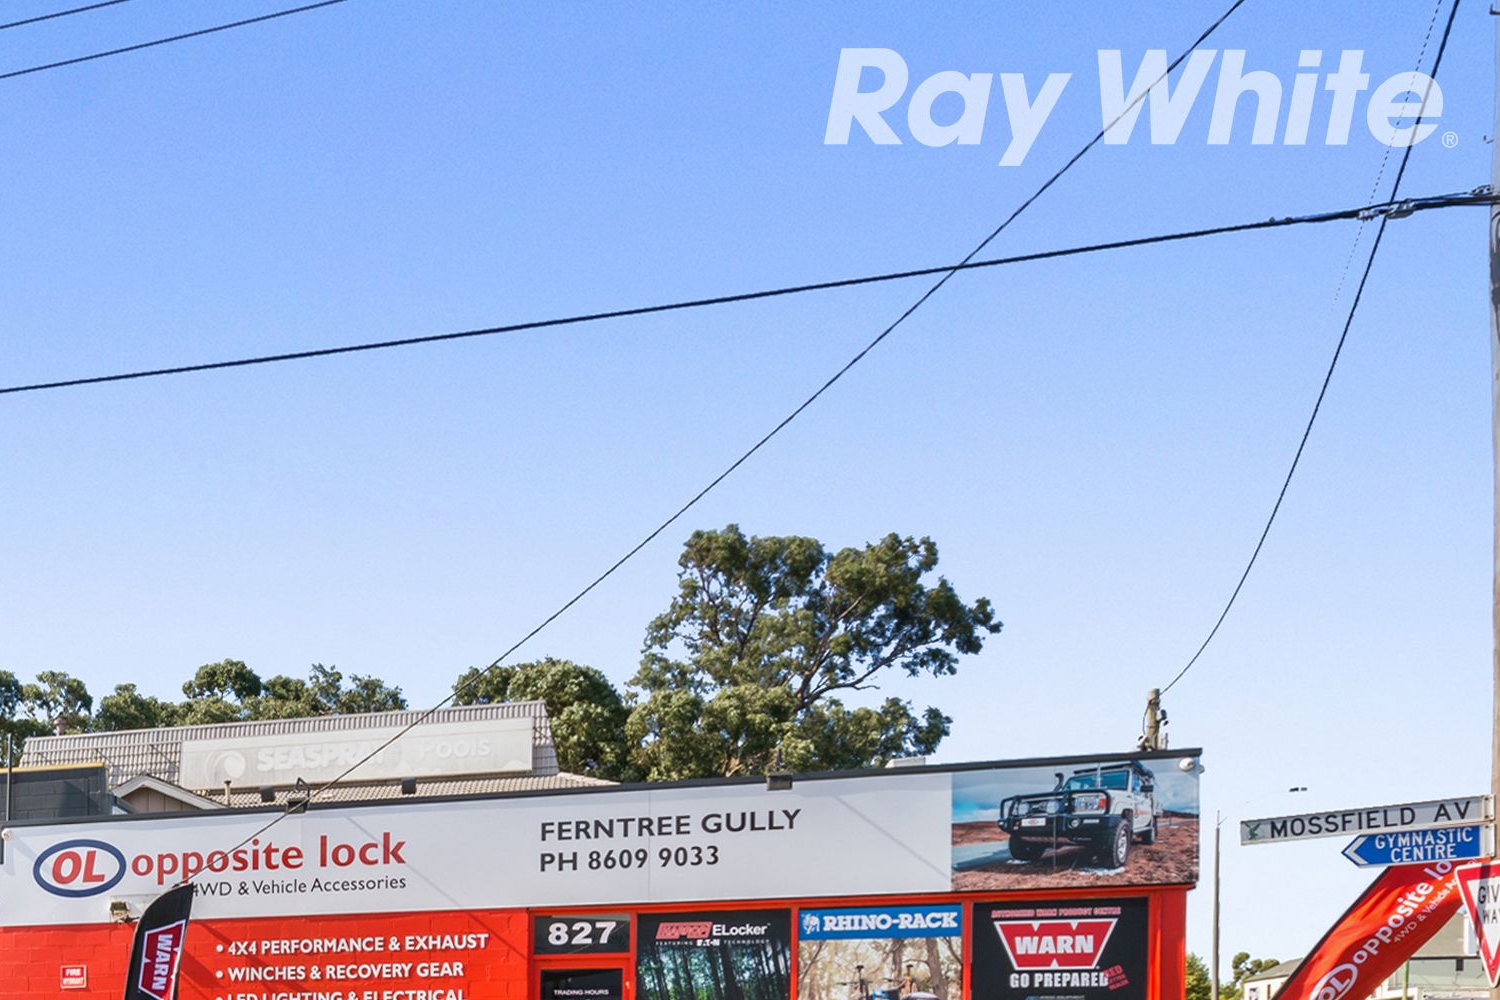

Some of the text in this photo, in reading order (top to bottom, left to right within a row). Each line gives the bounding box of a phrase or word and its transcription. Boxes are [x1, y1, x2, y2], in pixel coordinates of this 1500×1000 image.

[257, 741, 386, 772] SEASPRAY
[540, 809, 801, 841] FERNTREE GULLY
[1270, 800, 1471, 839] MOSSFIELD AV
[1375, 826, 1474, 850] GYMNASTIC
[51, 832, 407, 886] OL opposite lock
[539, 845, 719, 872] PH 8609 9033
[1390, 843, 1457, 864] CENTRE
[238, 881, 250, 896] &
[252, 878, 307, 895] Vehicle
[310, 875, 407, 893] Accessories
[548, 921, 617, 945] 827
[712, 922, 768, 936] ELocker
[823, 911, 959, 932] RHINO-RACK
[1352, 881, 1436, 965] opposite
[228, 933, 489, 956] 4X4 PERFORMANCE & EXHAUST
[1014, 934, 1094, 955] WARN
[151, 933, 173, 991] WARN
[228, 961, 464, 981] WINCHES & RECOVERY GEAR
[1009, 971, 1109, 989] GO PREPARED
